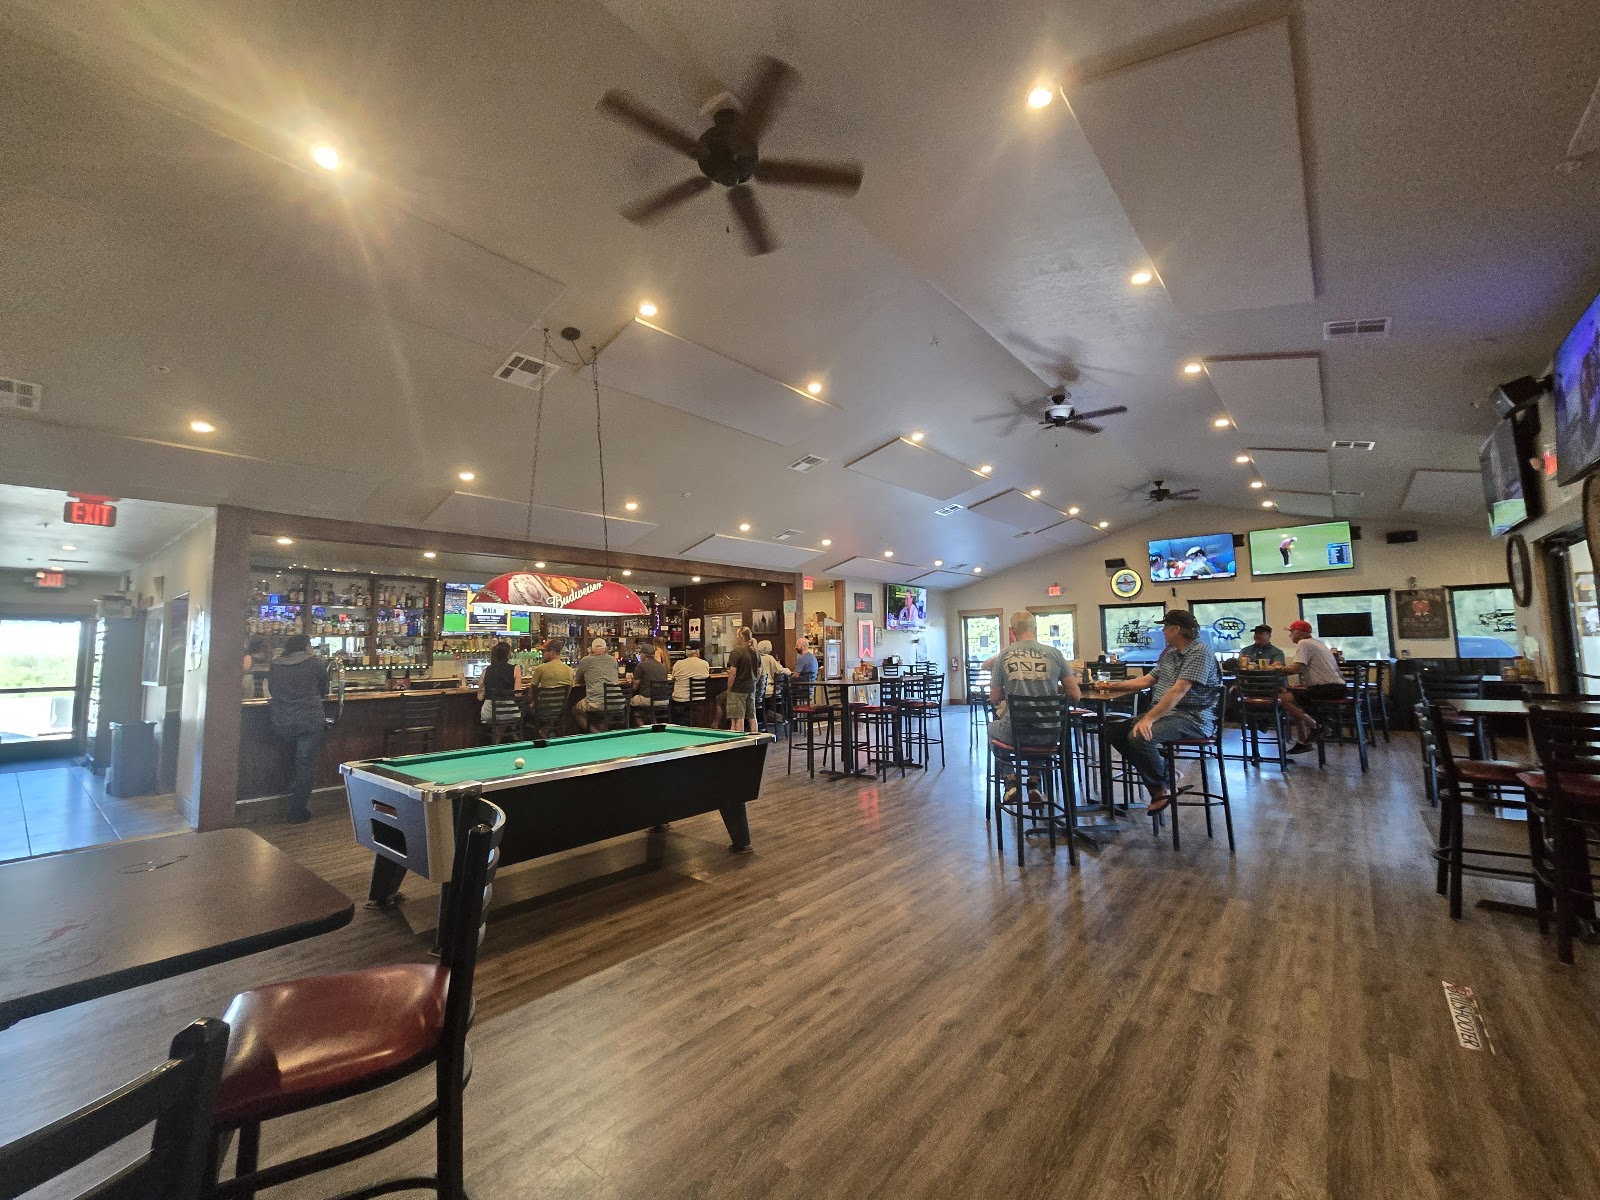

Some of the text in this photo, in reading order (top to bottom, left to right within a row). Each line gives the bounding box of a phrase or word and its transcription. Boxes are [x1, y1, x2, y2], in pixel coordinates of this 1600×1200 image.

[71, 503, 112, 526] EXIT
[546, 582, 603, 609] Budweiser
[707, 598, 726, 608] BAR
